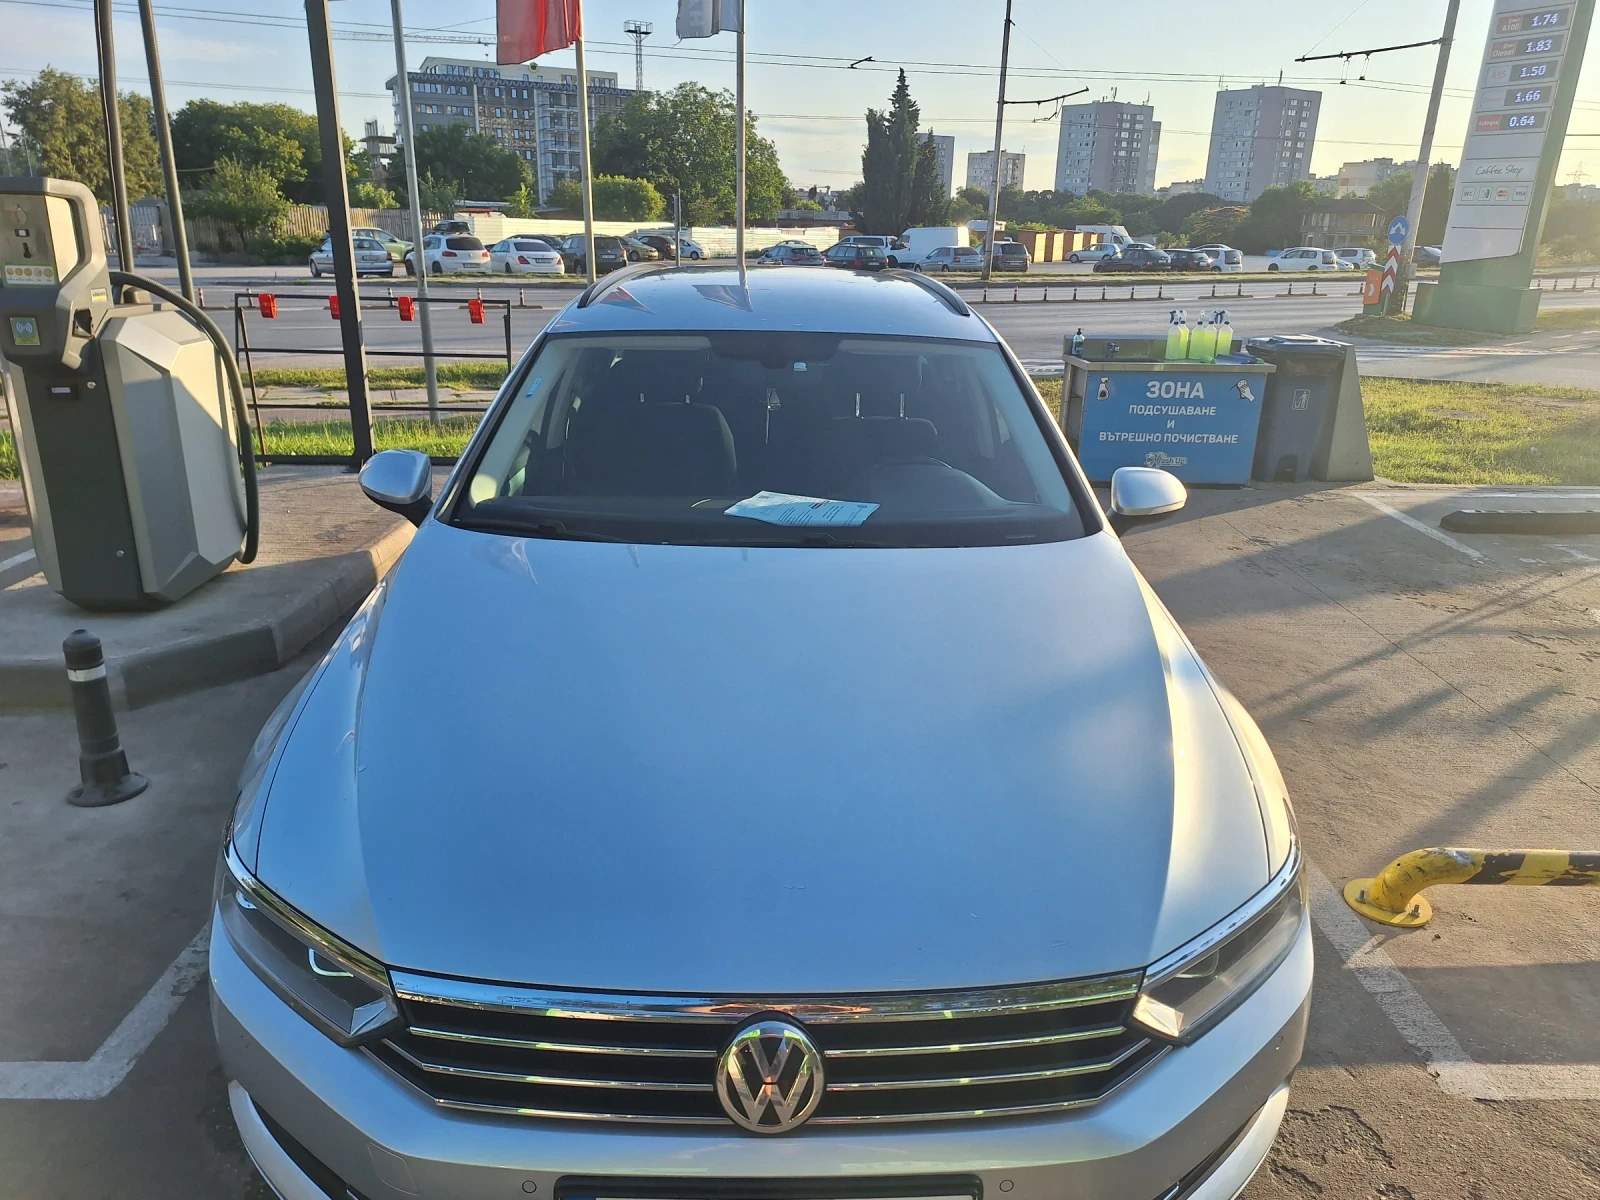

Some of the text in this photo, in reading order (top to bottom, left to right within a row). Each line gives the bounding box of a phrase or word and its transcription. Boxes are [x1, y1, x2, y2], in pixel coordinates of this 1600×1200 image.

[1531, 12, 1559, 27] 1.74
[1525, 38, 1553, 53] 1.83
[1492, 48, 1515, 57] Diesel
[1520, 65, 1547, 78] 1.50
[1514, 90, 1541, 103] 1.66
[1509, 115, 1535, 127] 0.64
[1475, 164, 1524, 177] Coffee Shop
[1145, 381, 1205, 399] ЗОНА
[1128, 405, 1217, 416] ПОДСУШАВАНЕ
[1166, 420, 1175, 429] И
[1099, 431, 1239, 444] ВЪТРЕШНО ПОЧИСТВАНЕ
